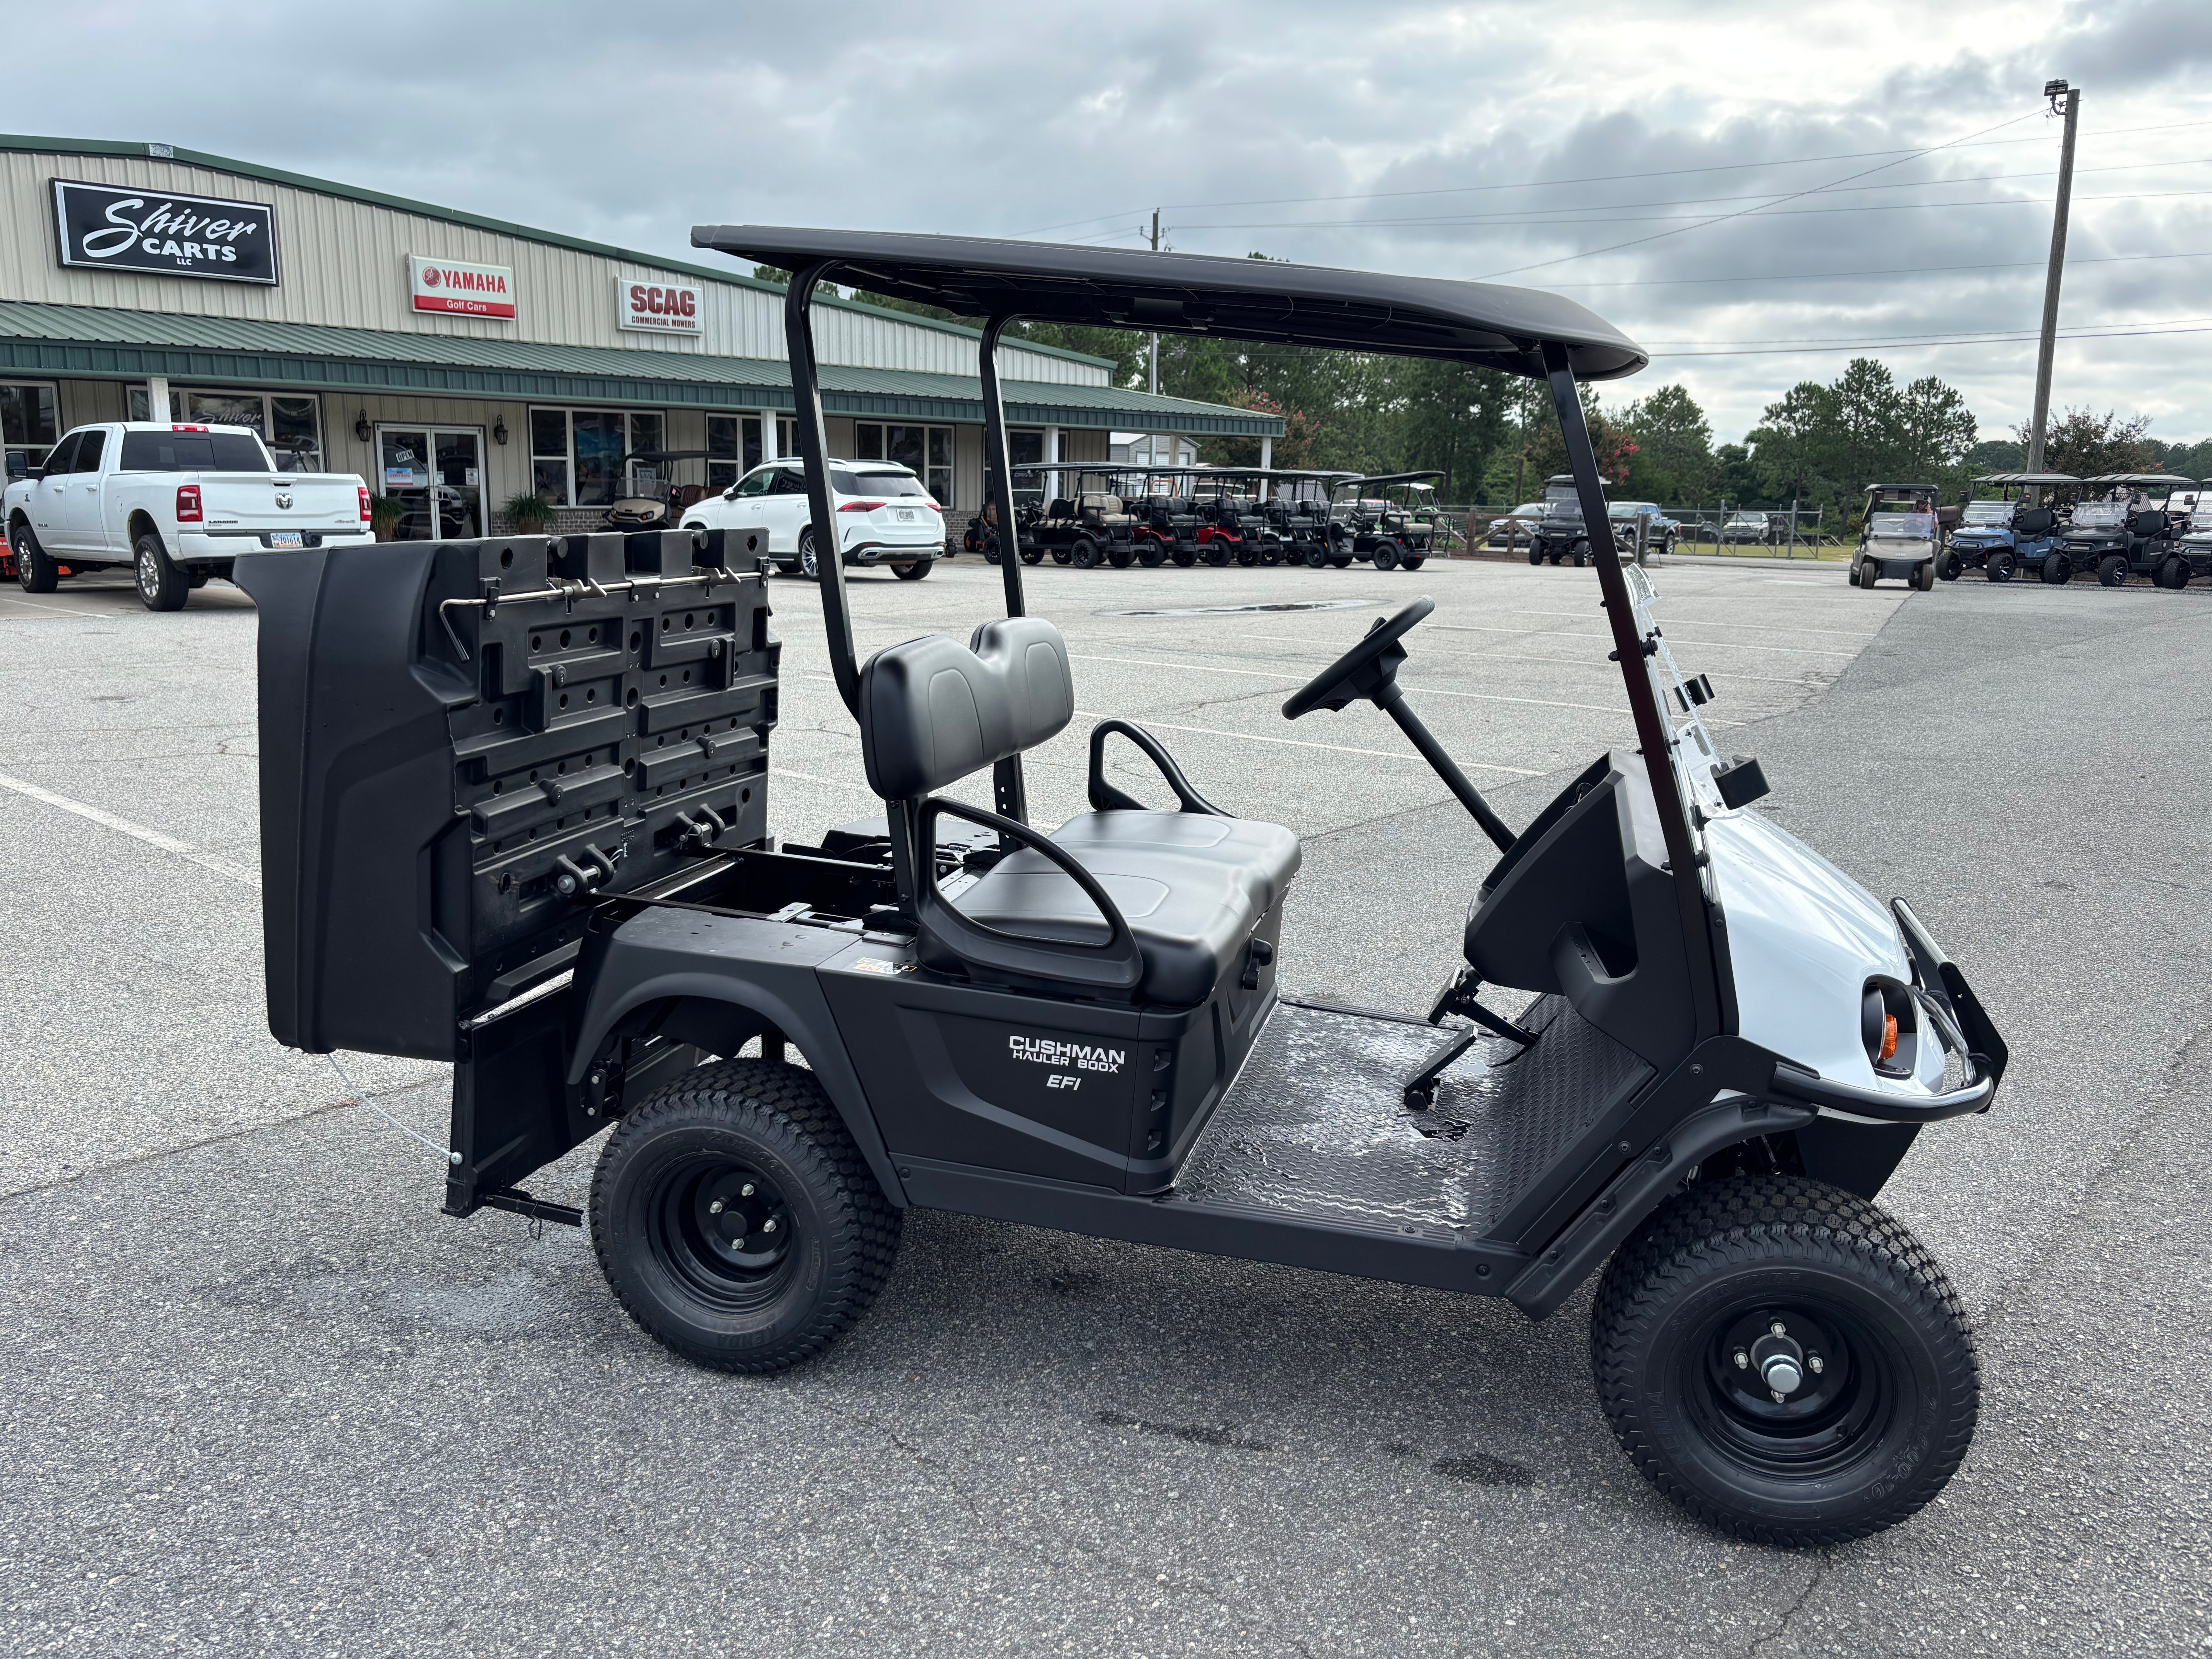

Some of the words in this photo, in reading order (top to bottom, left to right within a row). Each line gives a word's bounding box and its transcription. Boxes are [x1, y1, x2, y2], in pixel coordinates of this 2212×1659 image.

[82, 199, 257, 258] Shiver
[142, 238, 237, 262] CARTS
[177, 258, 192, 266] LLC
[442, 269, 507, 294] YAMAHA
[447, 299, 464, 310] Golf
[467, 301, 487, 311] Cars
[630, 285, 696, 317] SCAG
[632, 316, 670, 327] COMMERCIAL
[672, 319, 696, 328] MOWERS
[397, 450, 413, 461] OPEN
[1009, 1036, 1125, 1064] CUSHMAN
[1013, 1049, 1070, 1066] HAULER
[1077, 1059, 1119, 1073] 800X
[1046, 1074, 1082, 1091] EFI
[1669, 1283, 1731, 1333] SUPER
[1735, 1273, 1802, 1290] TURF
[717, 1323, 777, 1348] KENDA
[1645, 1391, 1693, 1465] KENDA
